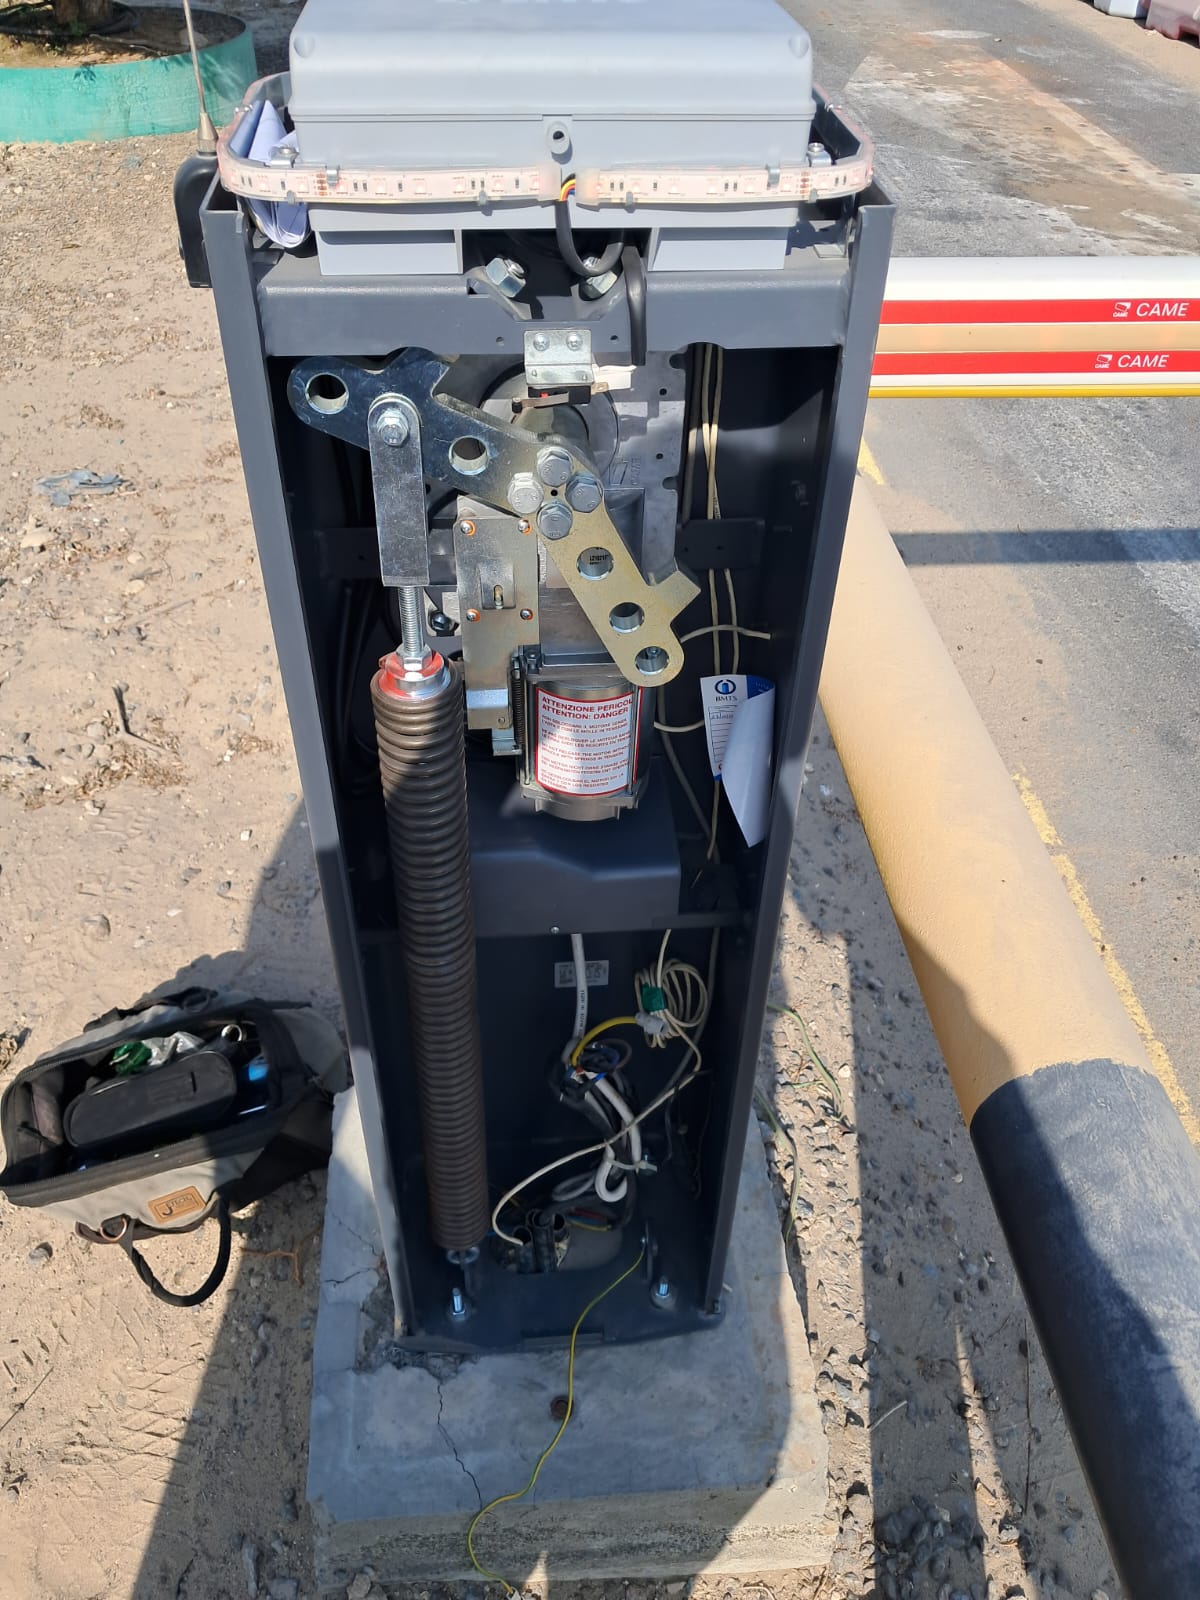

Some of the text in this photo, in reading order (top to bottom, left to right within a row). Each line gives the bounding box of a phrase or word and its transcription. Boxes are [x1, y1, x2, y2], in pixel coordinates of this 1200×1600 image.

[1136, 302, 1190, 316] CAME
[1118, 354, 1170, 368] CAME
[542, 696, 633, 712] ATTENZIONE PERICOL
[542, 704, 628, 720] ATTENTION: DANGER
